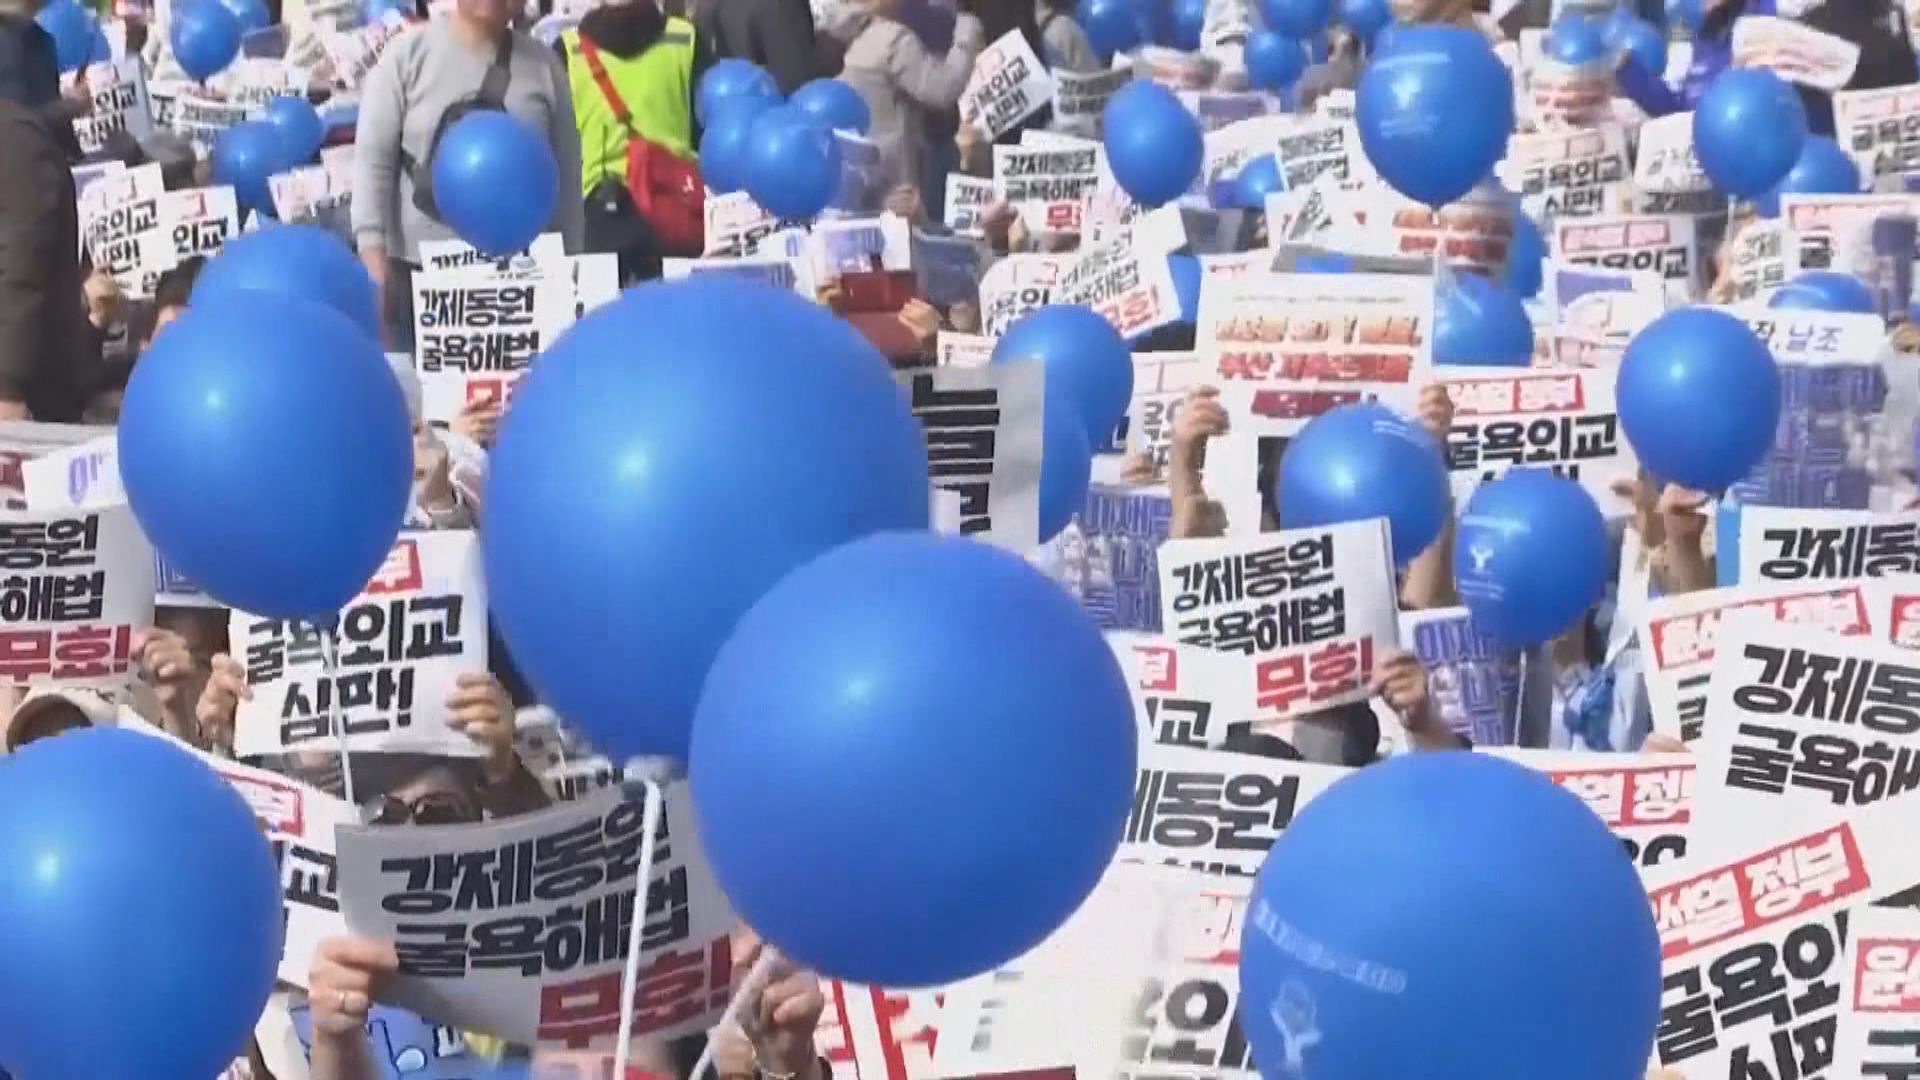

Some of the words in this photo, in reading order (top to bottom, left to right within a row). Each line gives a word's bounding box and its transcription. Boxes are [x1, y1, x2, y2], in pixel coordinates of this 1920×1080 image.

[172, 216, 229, 254] 외교
[419, 285, 536, 328] 강제동원
[422, 331, 541, 373] 굴욕해법
[0, 514, 99, 569] 동원
[1172, 534, 1334, 612] 강제동원
[1760, 523, 1920, 579] 강제동
[0, 571, 105, 622] 해법
[279, 667, 415, 746] 심판!
[1256, 637, 1375, 712] 무효!
[380, 800, 672, 915] 강제동원
[394, 865, 692, 978] 굴욕해법
[535, 932, 734, 1050] 무효!
[1654, 922, 1849, 1067] 굴욕외
